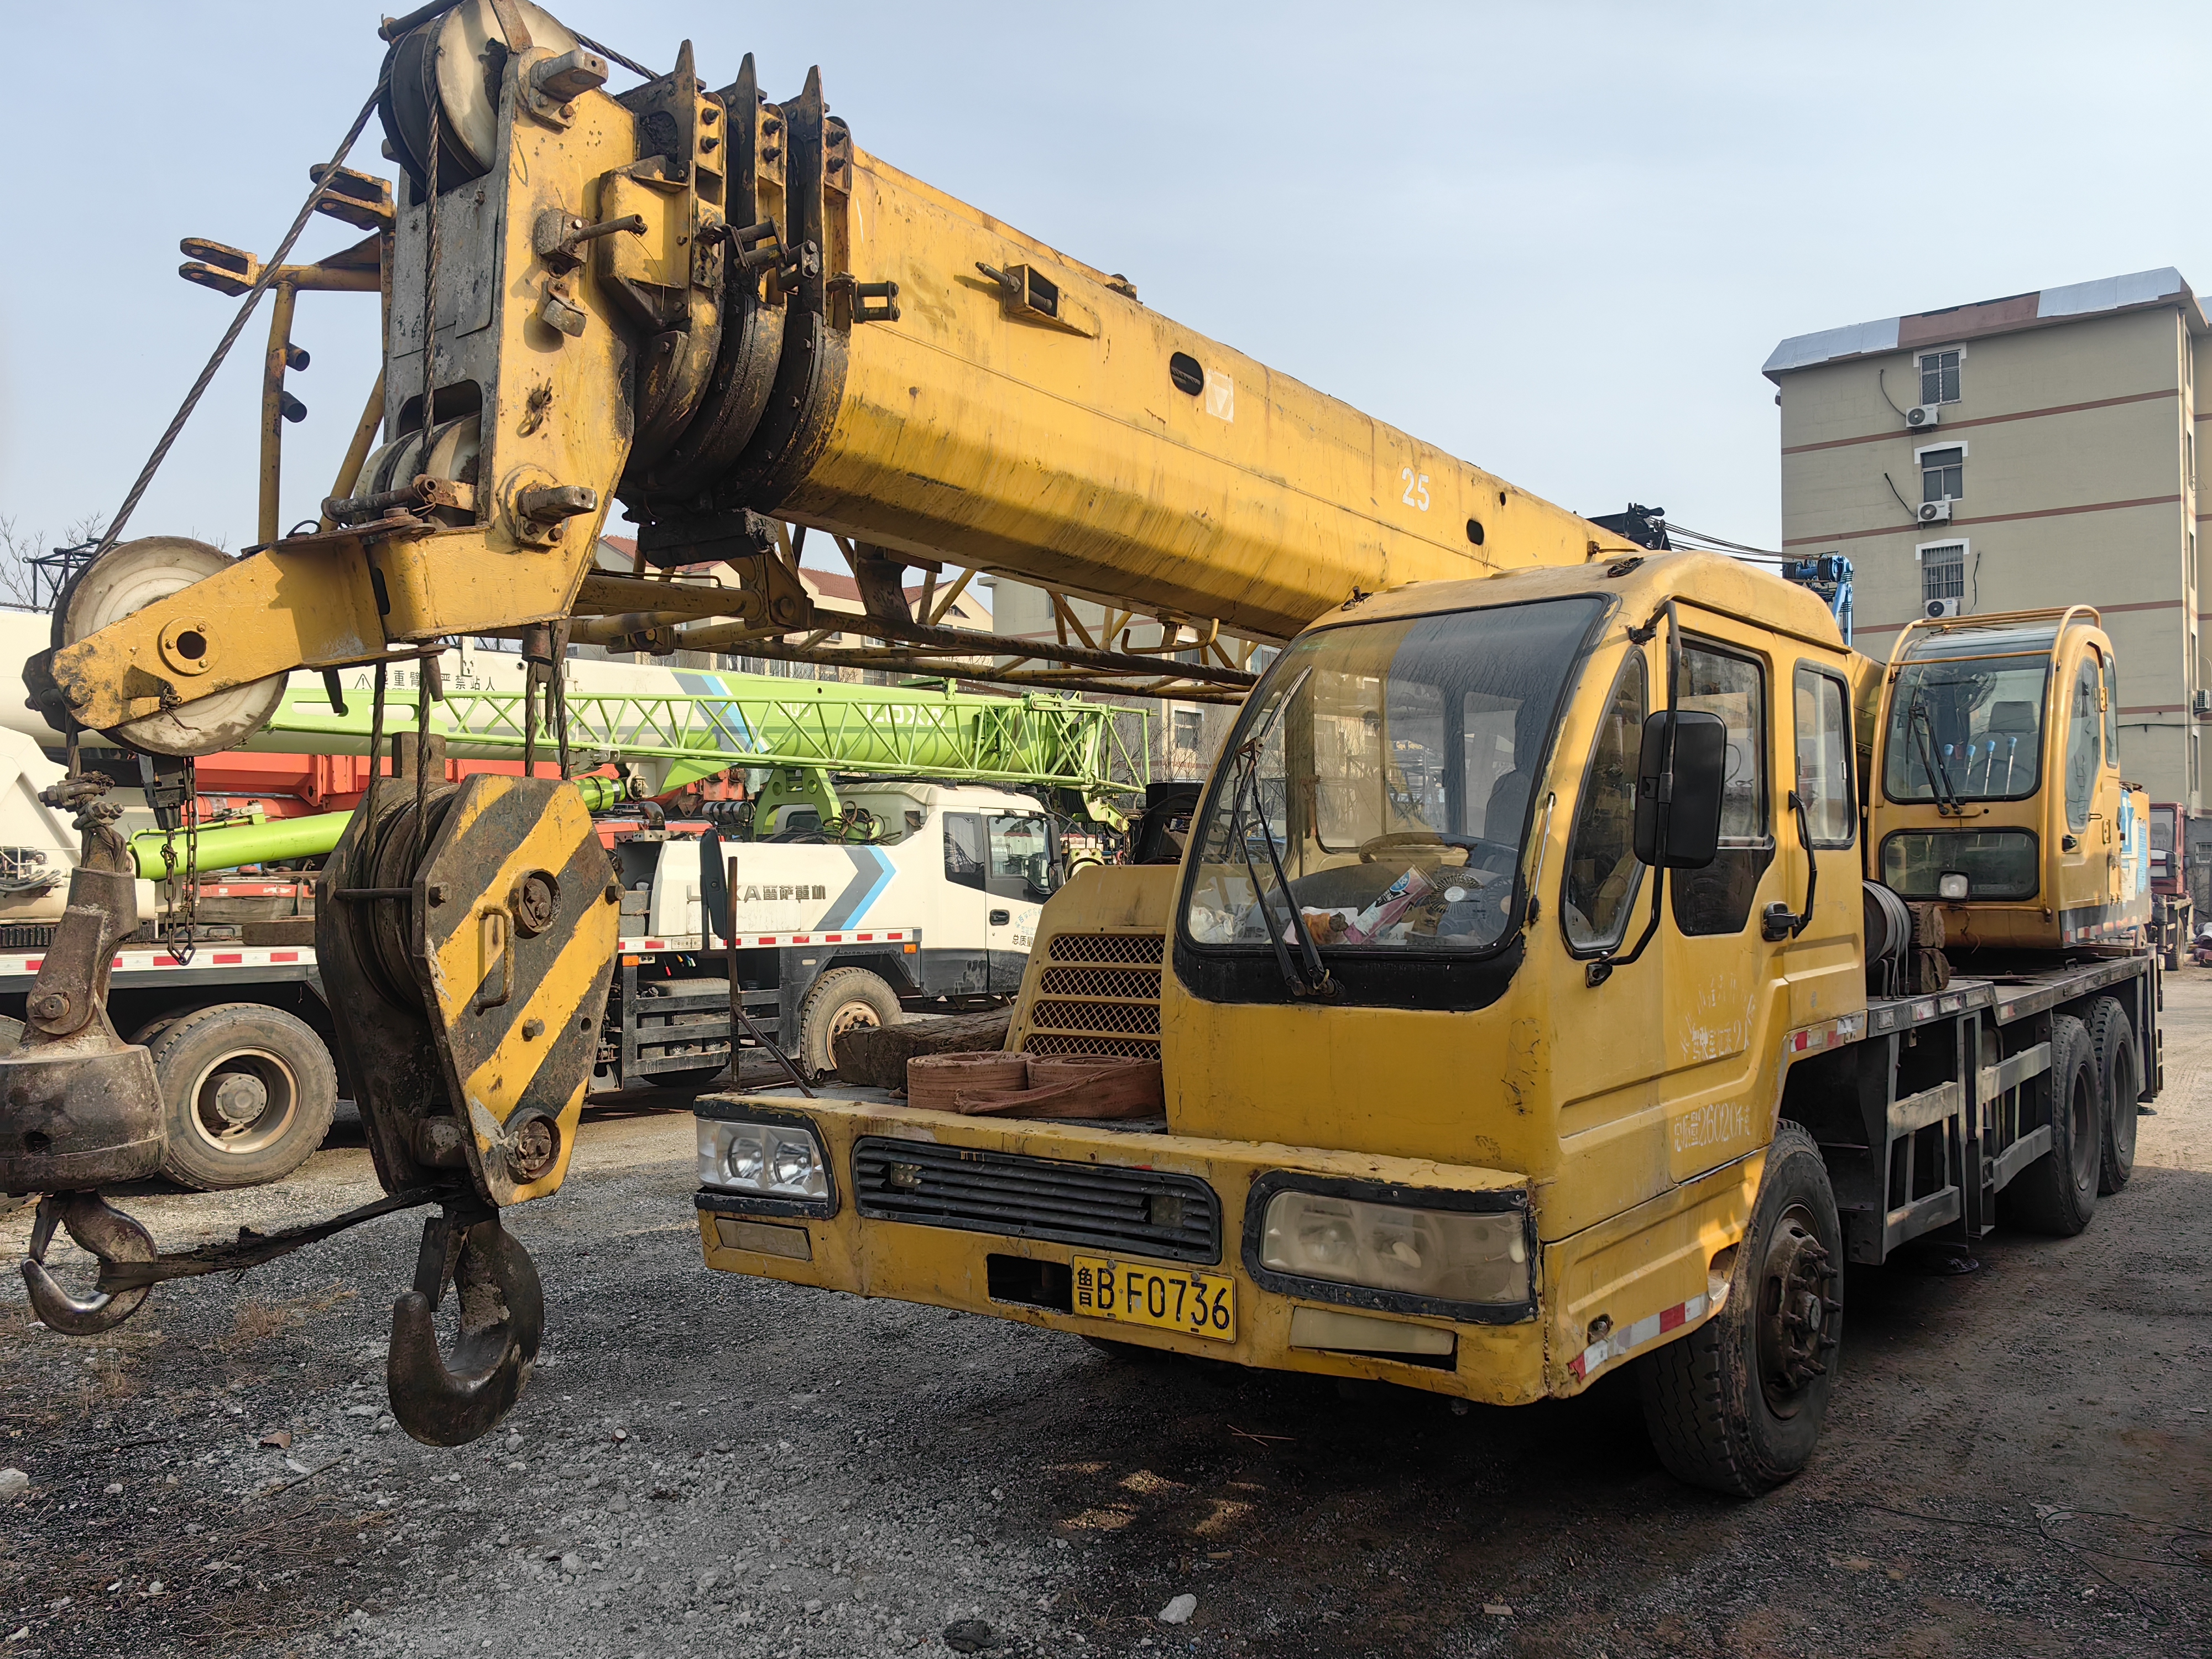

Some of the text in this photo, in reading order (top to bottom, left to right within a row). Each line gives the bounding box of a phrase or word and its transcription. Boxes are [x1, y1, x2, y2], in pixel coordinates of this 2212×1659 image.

[1401, 467, 1430, 512] 25
[867, 704, 946, 727] LOXA
[763, 885, 826, 900] 雷萨重机
